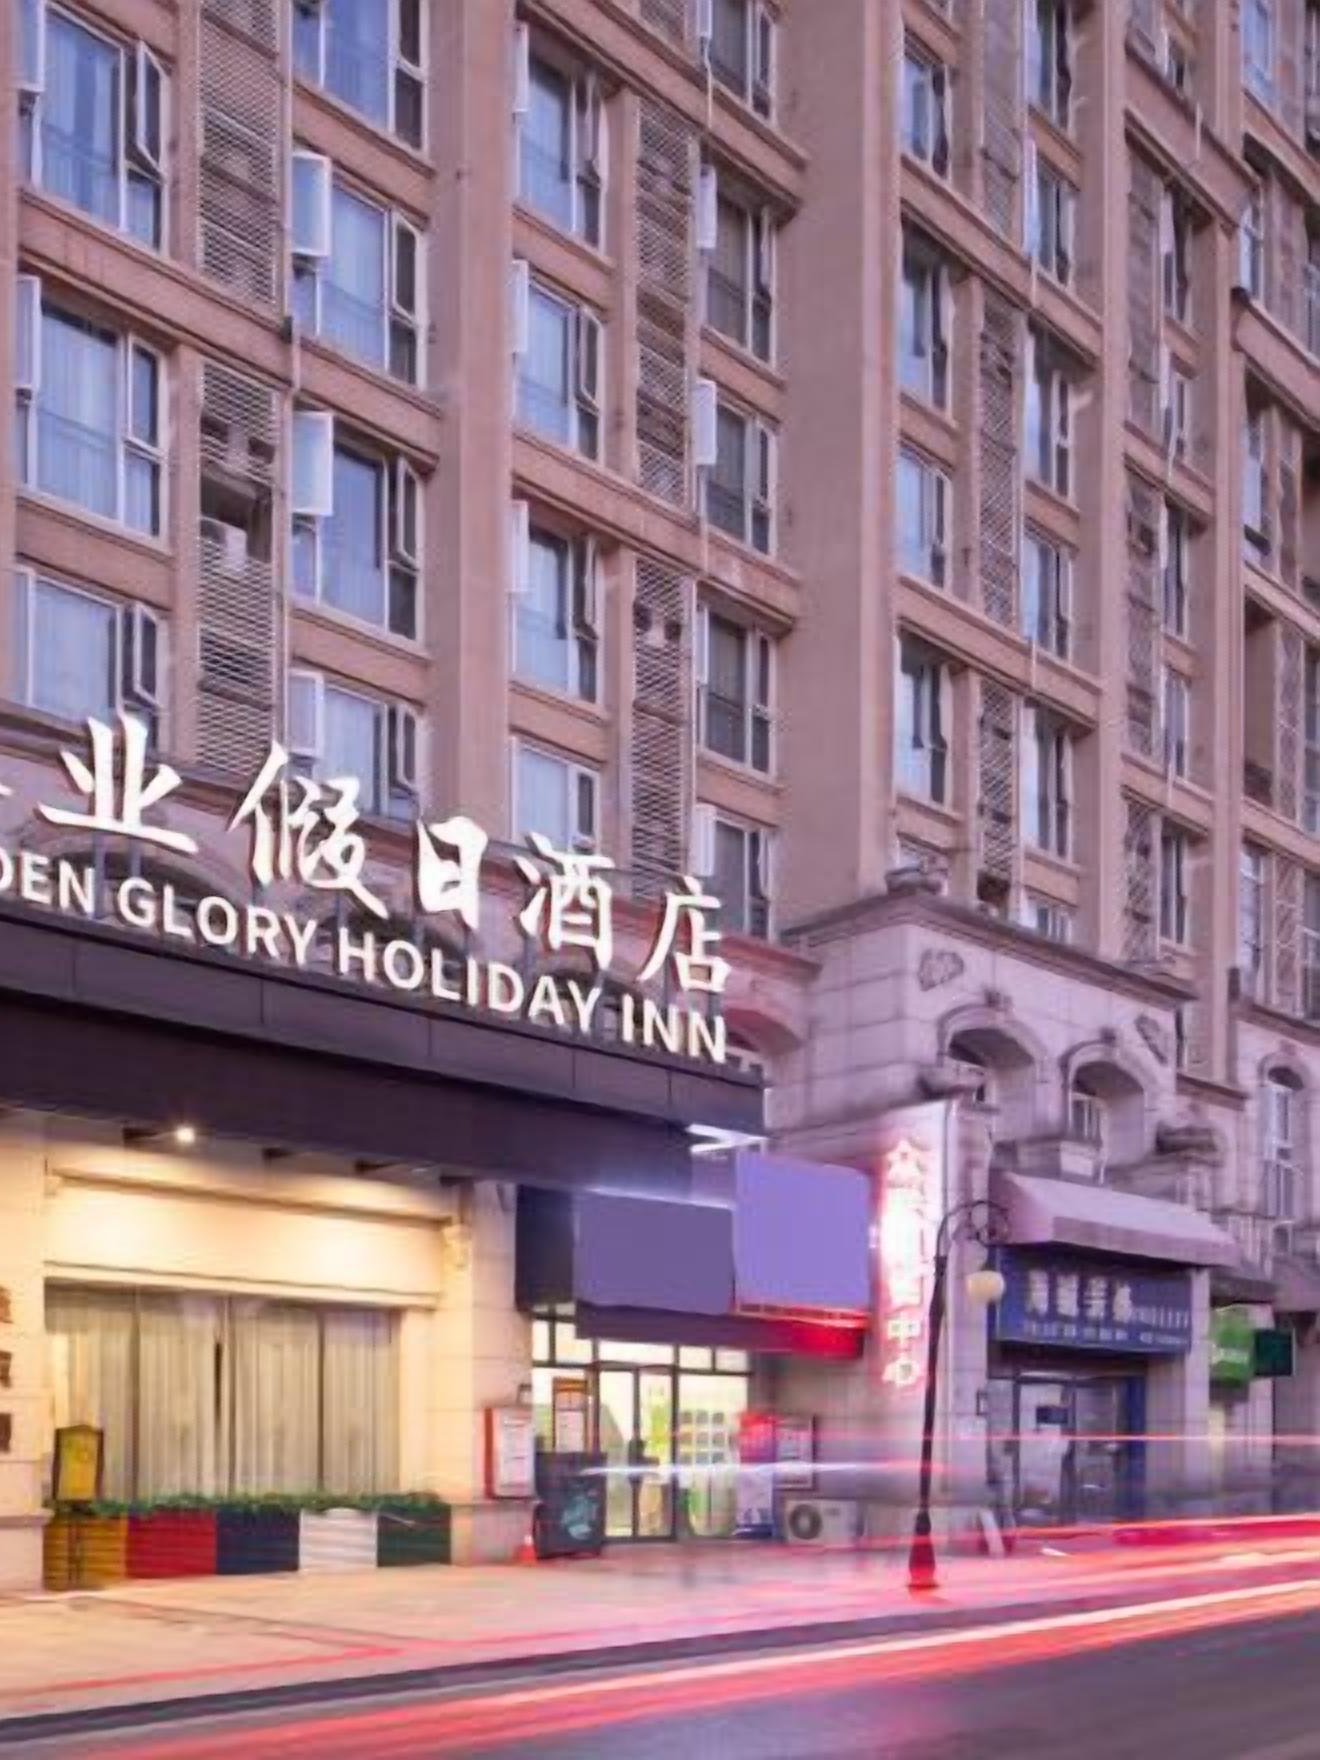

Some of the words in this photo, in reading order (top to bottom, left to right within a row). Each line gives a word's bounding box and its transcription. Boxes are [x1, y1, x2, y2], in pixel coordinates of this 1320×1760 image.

[117, 877, 318, 966] GLORY
[338, 926, 601, 1034] HOLIDAY
[622, 995, 727, 1064] INN
